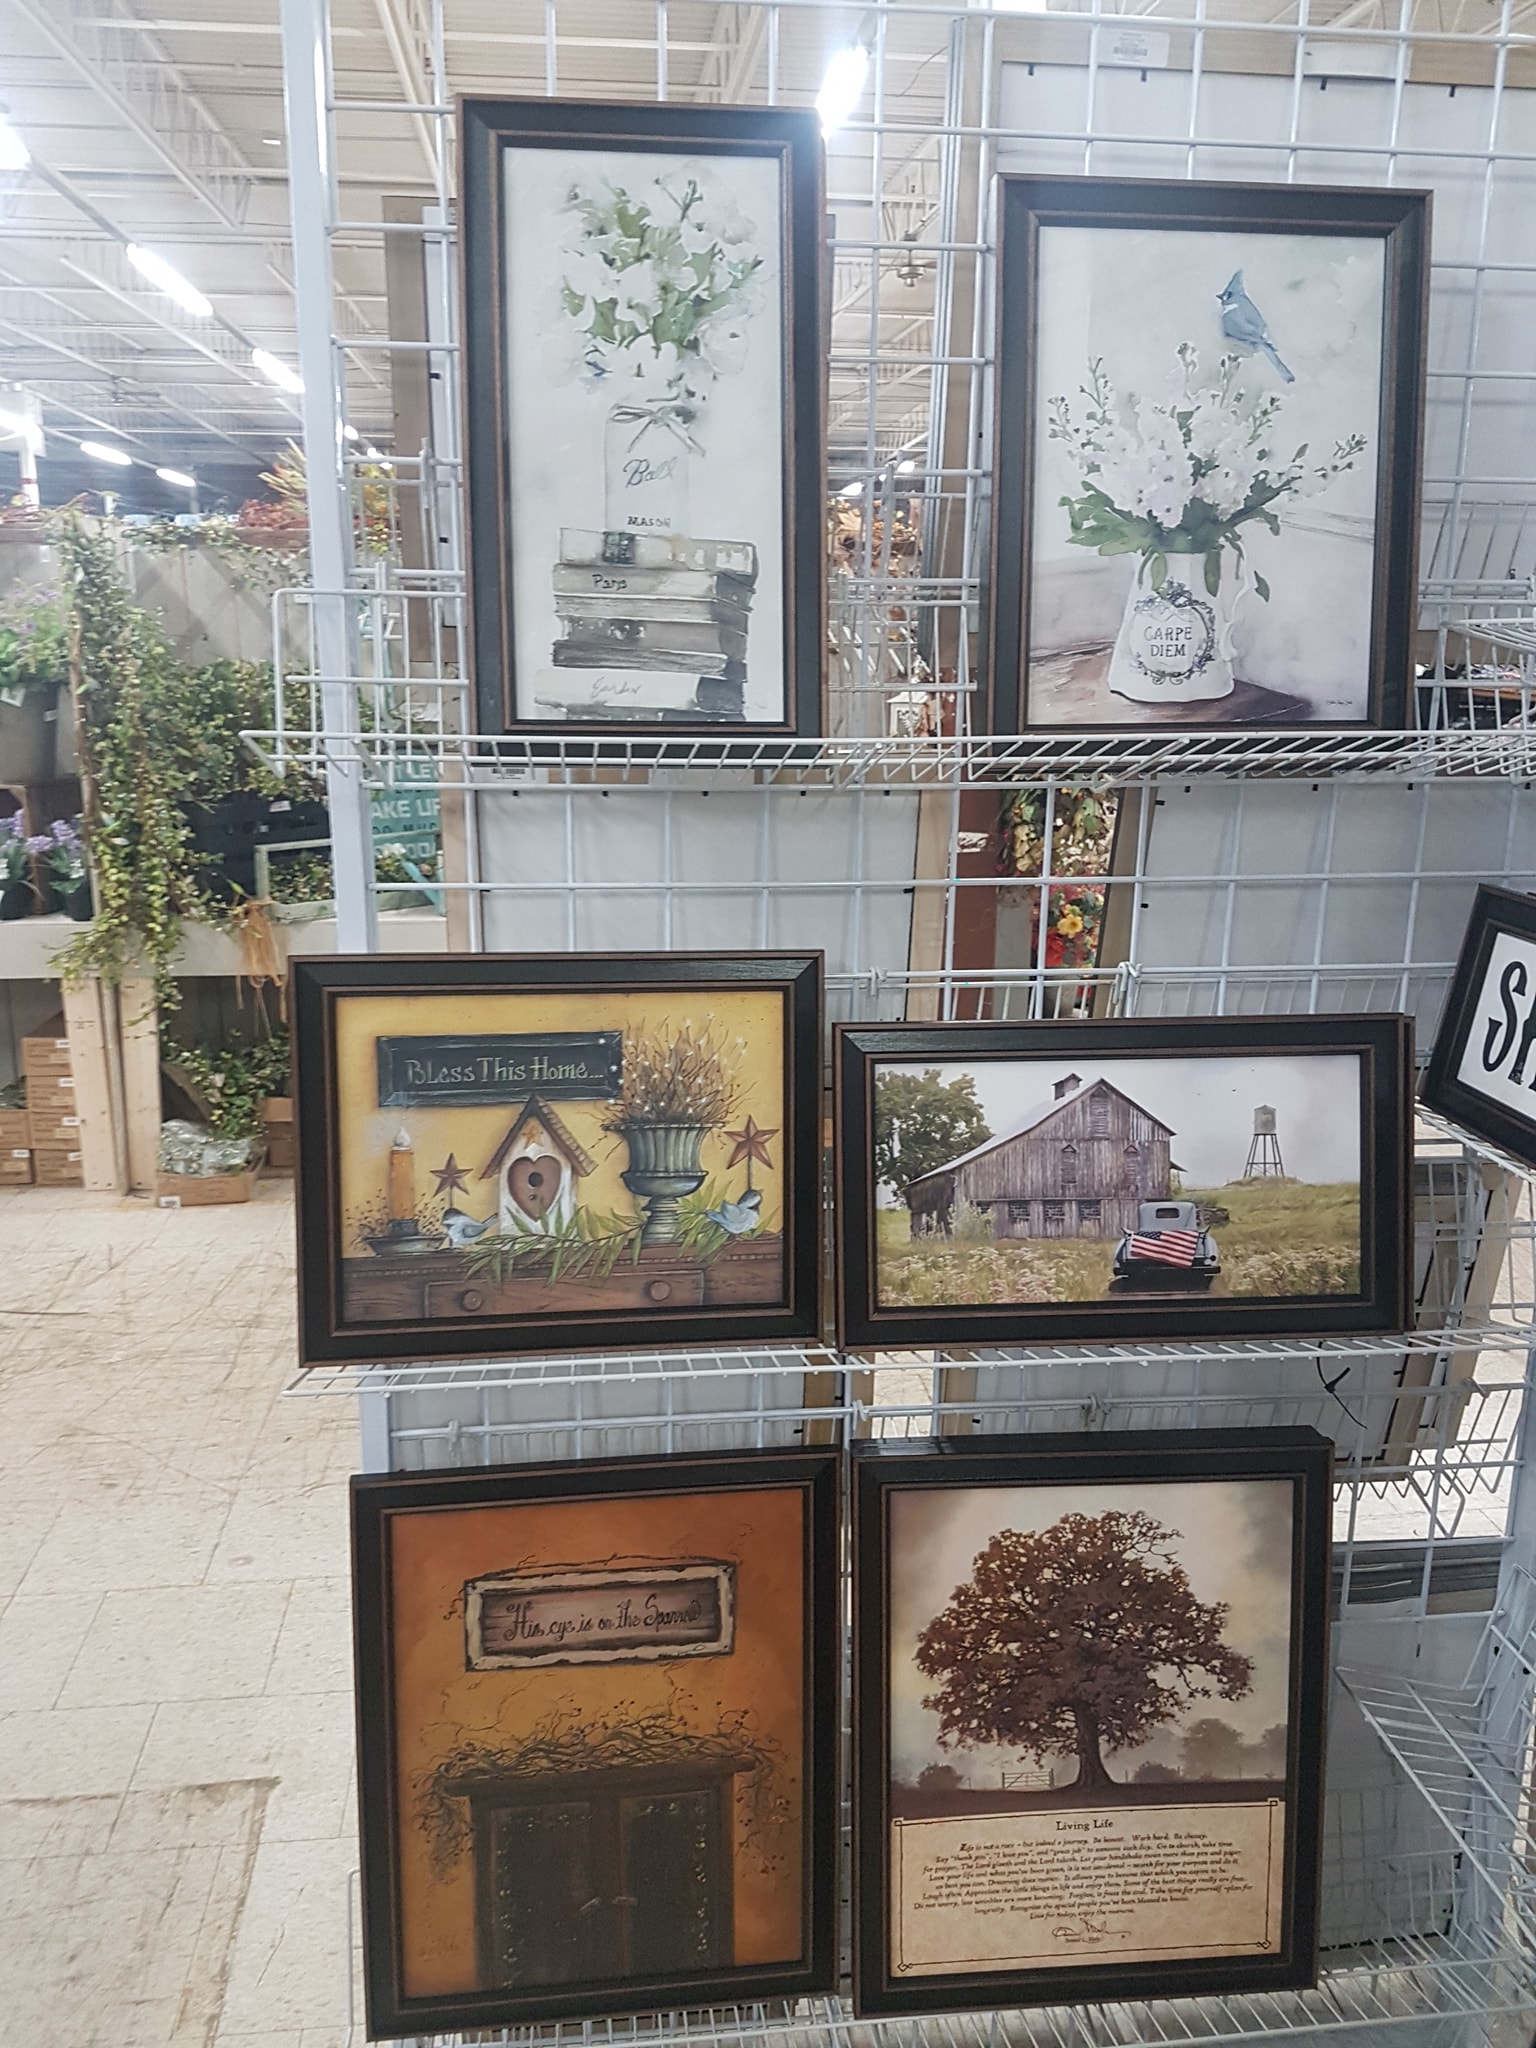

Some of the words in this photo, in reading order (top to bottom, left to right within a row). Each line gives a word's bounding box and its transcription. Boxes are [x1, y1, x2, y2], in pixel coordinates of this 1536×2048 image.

[623, 457, 678, 488] Ball
[1143, 625, 1193, 641] CARPE
[1150, 643, 1187, 658] DIEM
[372, 799, 411, 818] AKE
[476, 1056, 527, 1082] This
[504, 1600, 546, 1641] His
[576, 1613, 594, 1634] is
[597, 1616, 614, 1630] on
[614, 1599, 642, 1631] the
[1055, 1820, 1091, 1832] Living
[1093, 1818, 1114, 1829] Life
